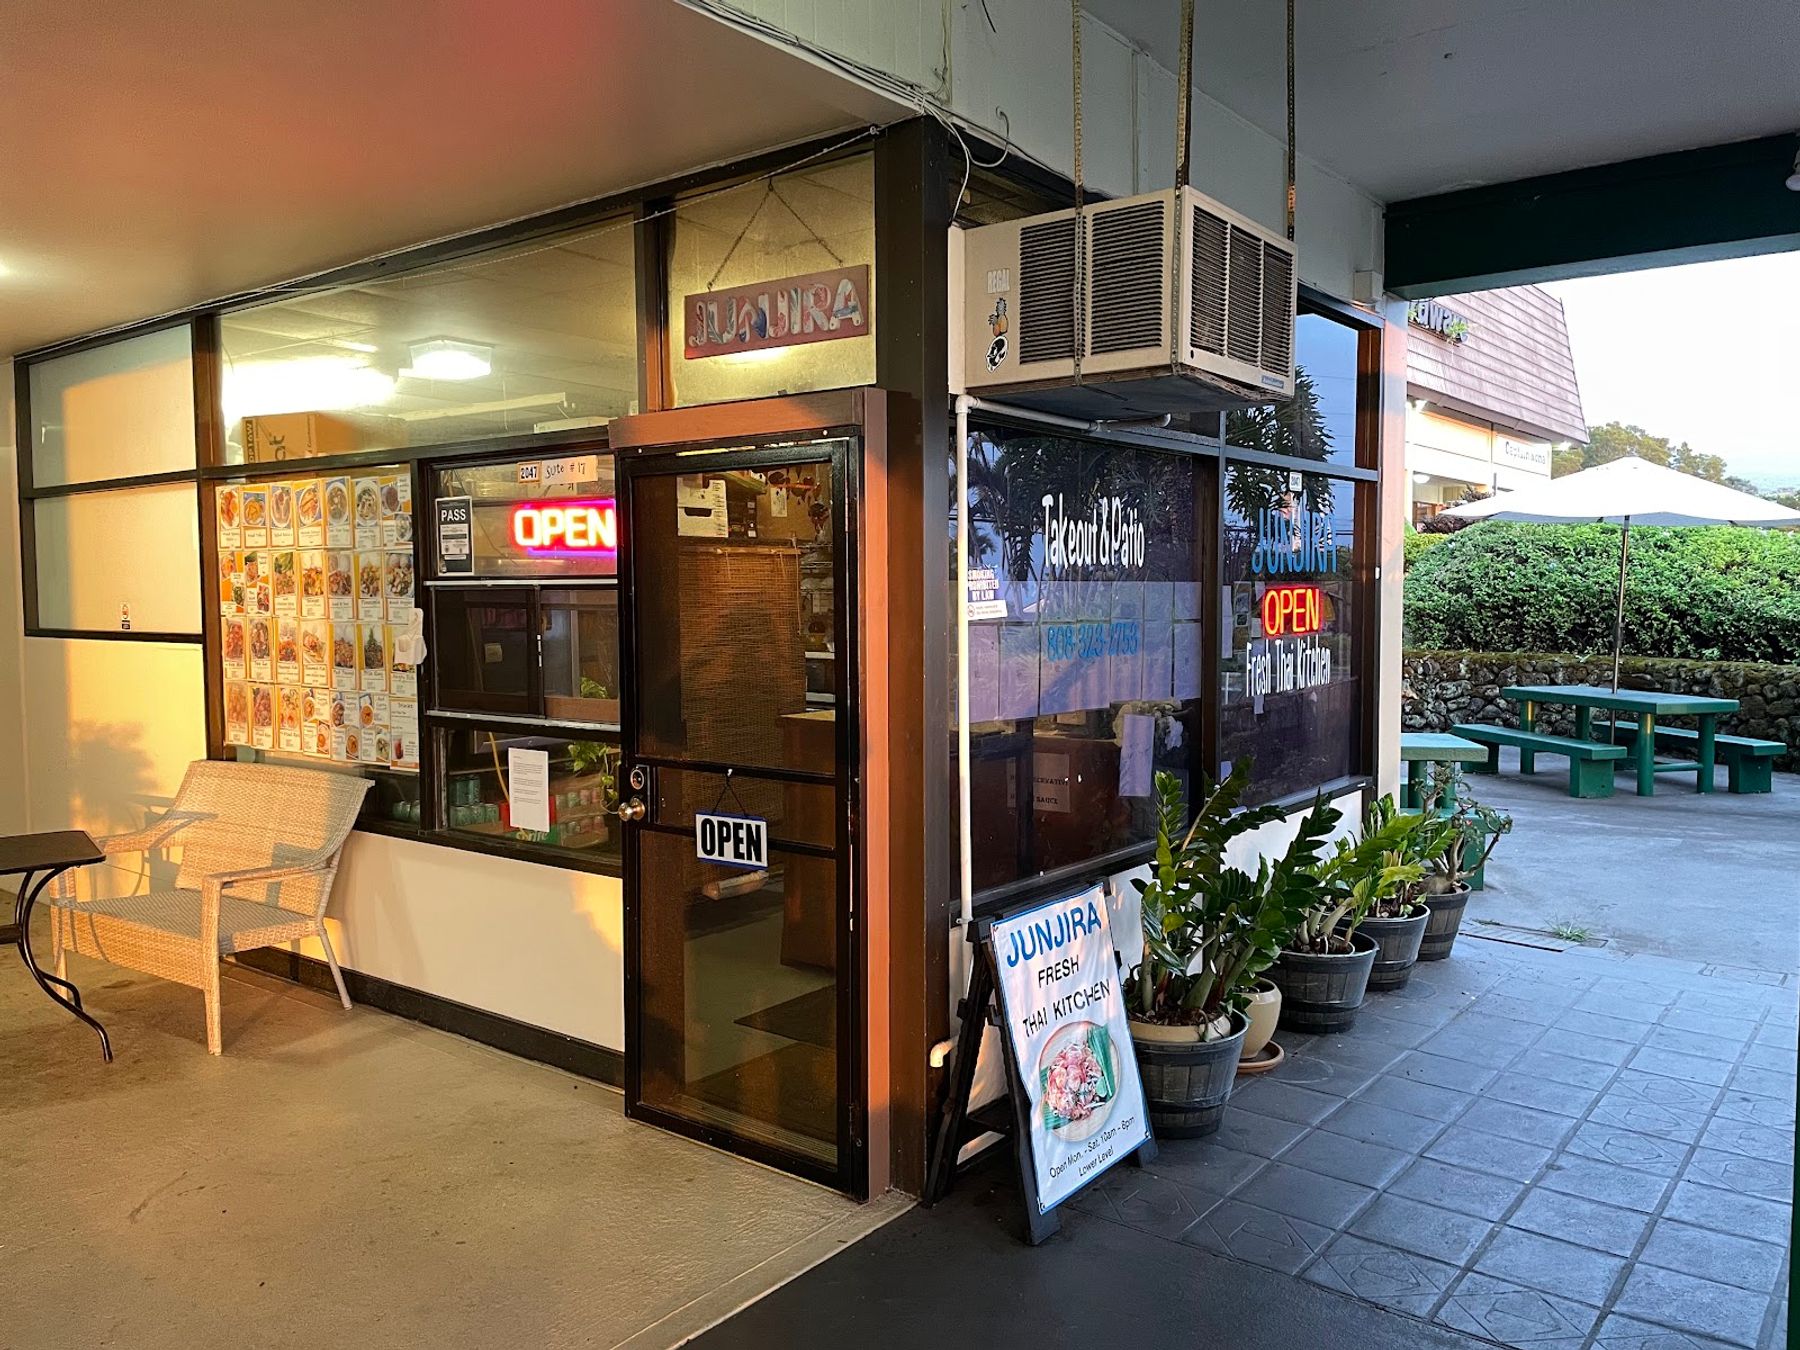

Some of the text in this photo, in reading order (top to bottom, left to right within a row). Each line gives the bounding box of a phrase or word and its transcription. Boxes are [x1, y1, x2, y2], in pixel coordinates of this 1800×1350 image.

[688, 278, 864, 348] JUNJIRA
[520, 466, 538, 480] 2047
[440, 508, 467, 521] PASS
[513, 508, 617, 548] OPEN
[1041, 492, 1145, 569] Takeout & Patio
[1252, 504, 1338, 575] JUNJIRA
[1264, 587, 1320, 635] OPEN
[1246, 634, 1331, 697] Fresh Thai Kitchen
[1036, 796, 1058, 805] SAUCE
[699, 817, 763, 862] OPEN
[1006, 902, 1102, 968] JUNJIRA
[1037, 955, 1080, 988] FRESH
[1022, 979, 1111, 1038] THAI KITCHEN
[1049, 1161, 1068, 1178] Open
[1078, 1145, 1114, 1177] Lower Level
